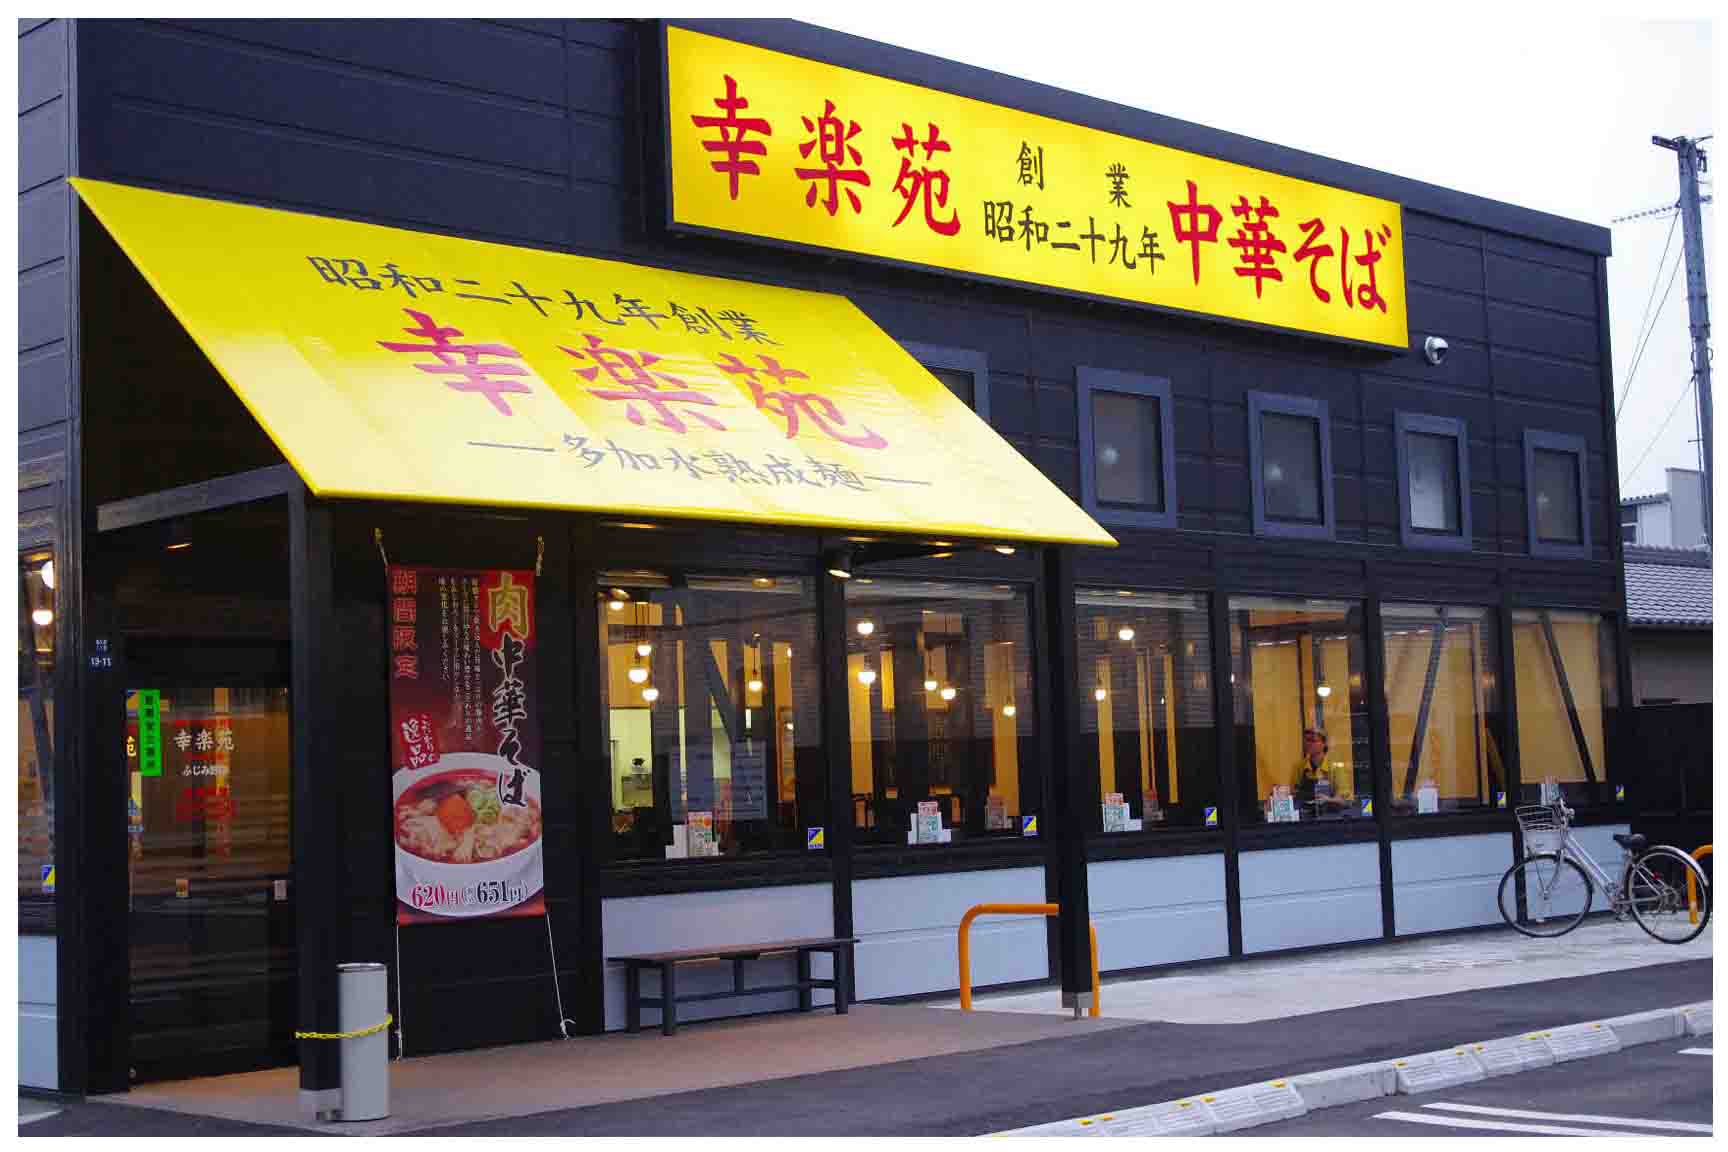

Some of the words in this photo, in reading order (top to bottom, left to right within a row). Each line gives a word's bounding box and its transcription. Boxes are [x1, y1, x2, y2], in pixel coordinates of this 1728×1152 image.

[691, 75, 961, 237] 幸楽苑
[983, 200, 1166, 276] 昭和二十九年
[1167, 180, 1392, 313] 中華そば
[306, 255, 784, 346] 昭和二十九年創業
[376, 308, 888, 449] 幸楽苑
[392, 570, 417, 680] 期間限定
[173, 728, 235, 750] 幸楽苑
